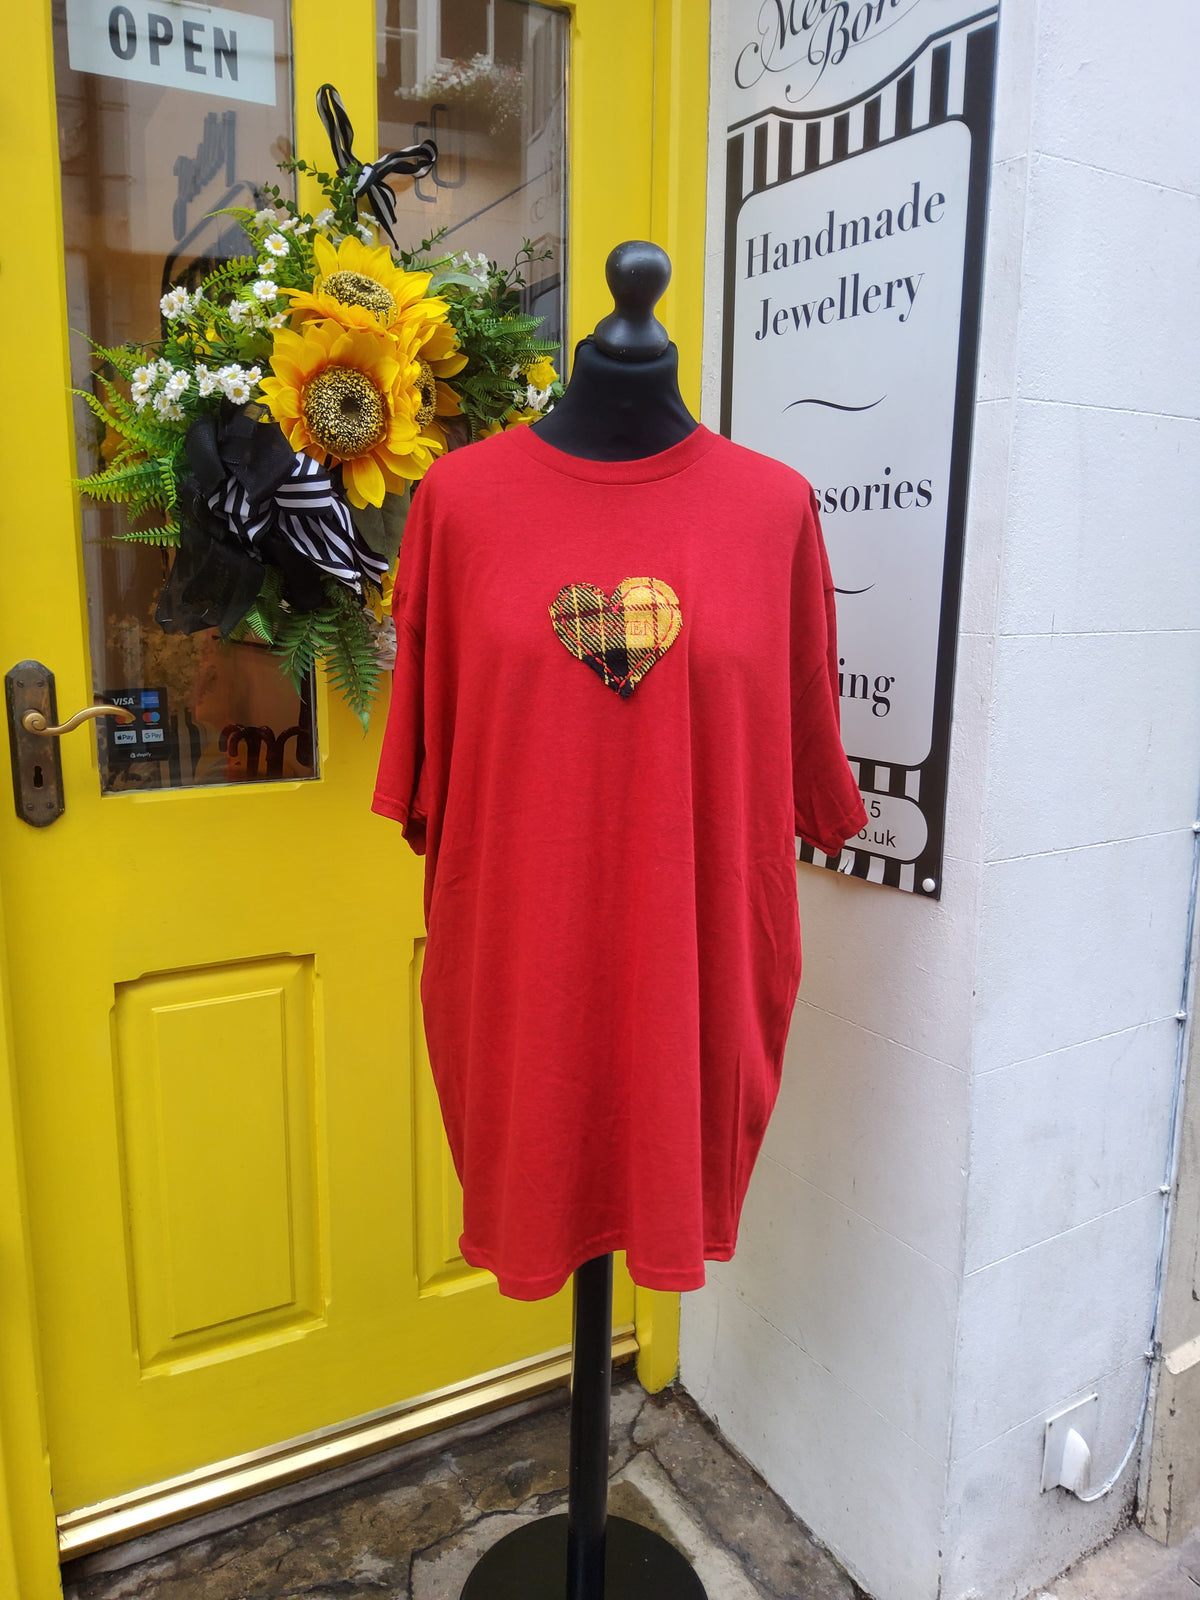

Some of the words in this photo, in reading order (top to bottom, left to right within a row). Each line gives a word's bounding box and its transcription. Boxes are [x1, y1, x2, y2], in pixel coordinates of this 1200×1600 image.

[108, 5, 239, 82] OPEN
[744, 181, 946, 280] Handmade
[755, 271, 926, 341] Jewellery
[112, 697, 134, 706] VISA
[862, 798, 881, 818] 5
